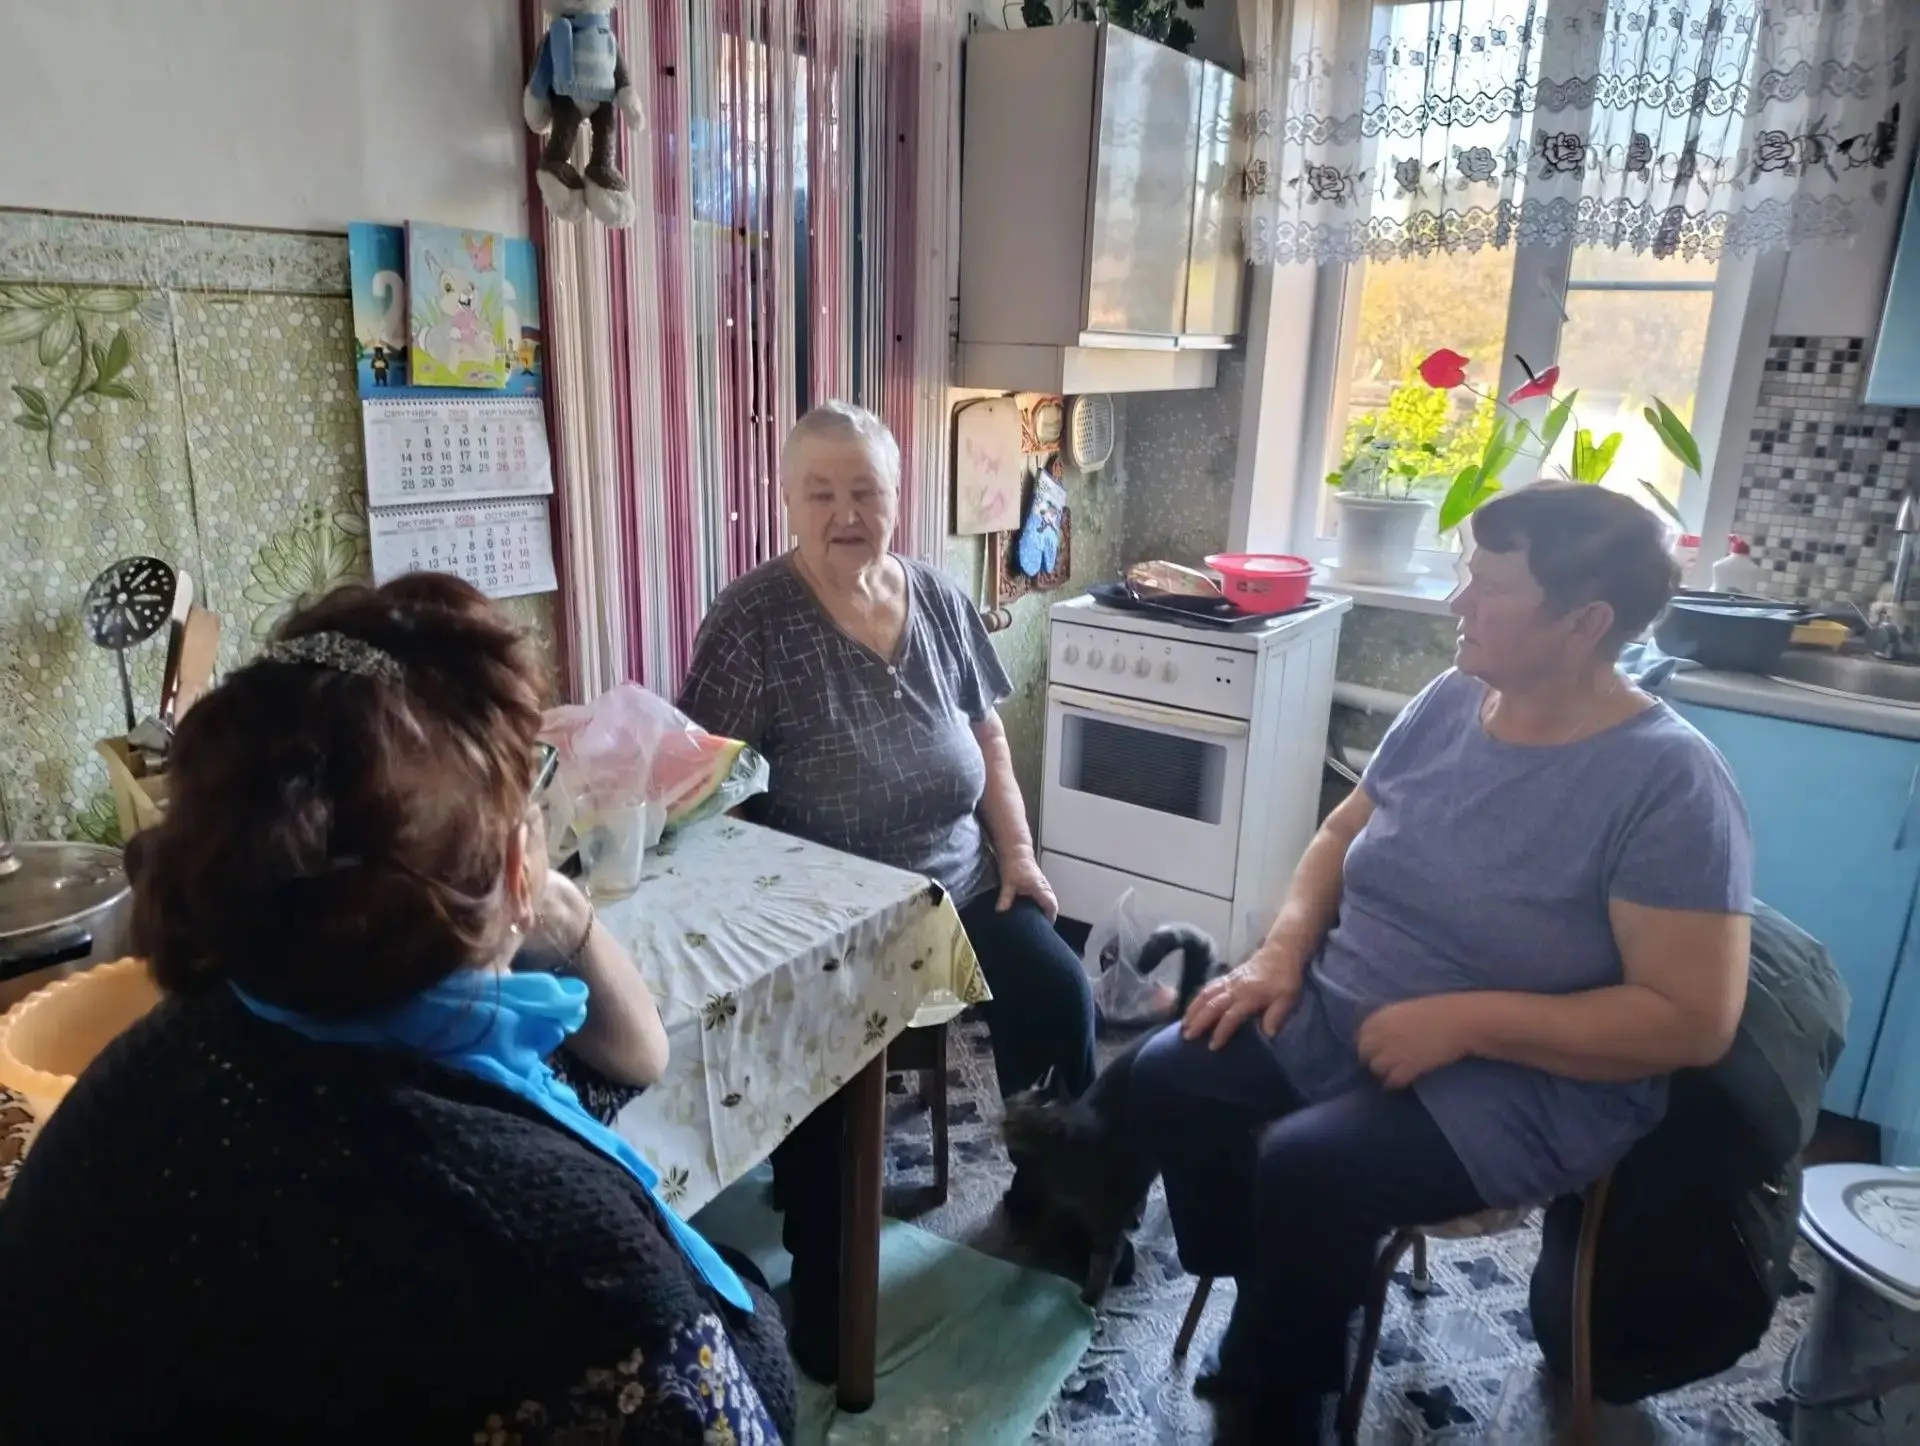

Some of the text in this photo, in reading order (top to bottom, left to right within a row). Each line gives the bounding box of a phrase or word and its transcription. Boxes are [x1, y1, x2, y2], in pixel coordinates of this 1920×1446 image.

[443, 425, 449, 435] 2
[462, 425, 469, 435] 3
[480, 424, 487, 434] 4
[404, 436, 524, 449] 7 8 9 10 11 12 13
[401, 449, 525, 463] 14 15 16 17 18 19 20
[401, 463, 526, 477] 21 22 23 24 25 26 27
[401, 478, 454, 490] 28 29 30
[397, 518, 444, 529] ОКТЯБРЬ
[485, 510, 528, 521] OCTOBER
[487, 527, 493, 536] 2
[505, 526, 511, 535] 3
[521, 524, 527, 533] 4
[411, 536, 527, 557] 5 6 7 8 9 10 11
[428, 559, 440, 569] 13
[447, 556, 458, 566] 14
[466, 554, 477, 564] 15
[484, 552, 495, 561] 16
[502, 550, 511, 559] 17
[519, 548, 529, 557] 18
[466, 567, 478, 577] 22
[484, 565, 496, 574] 23
[502, 563, 513, 572] 24
[519, 560, 531, 570] 25
[486, 576, 497, 586] 30
[503, 575, 514, 584] 31
